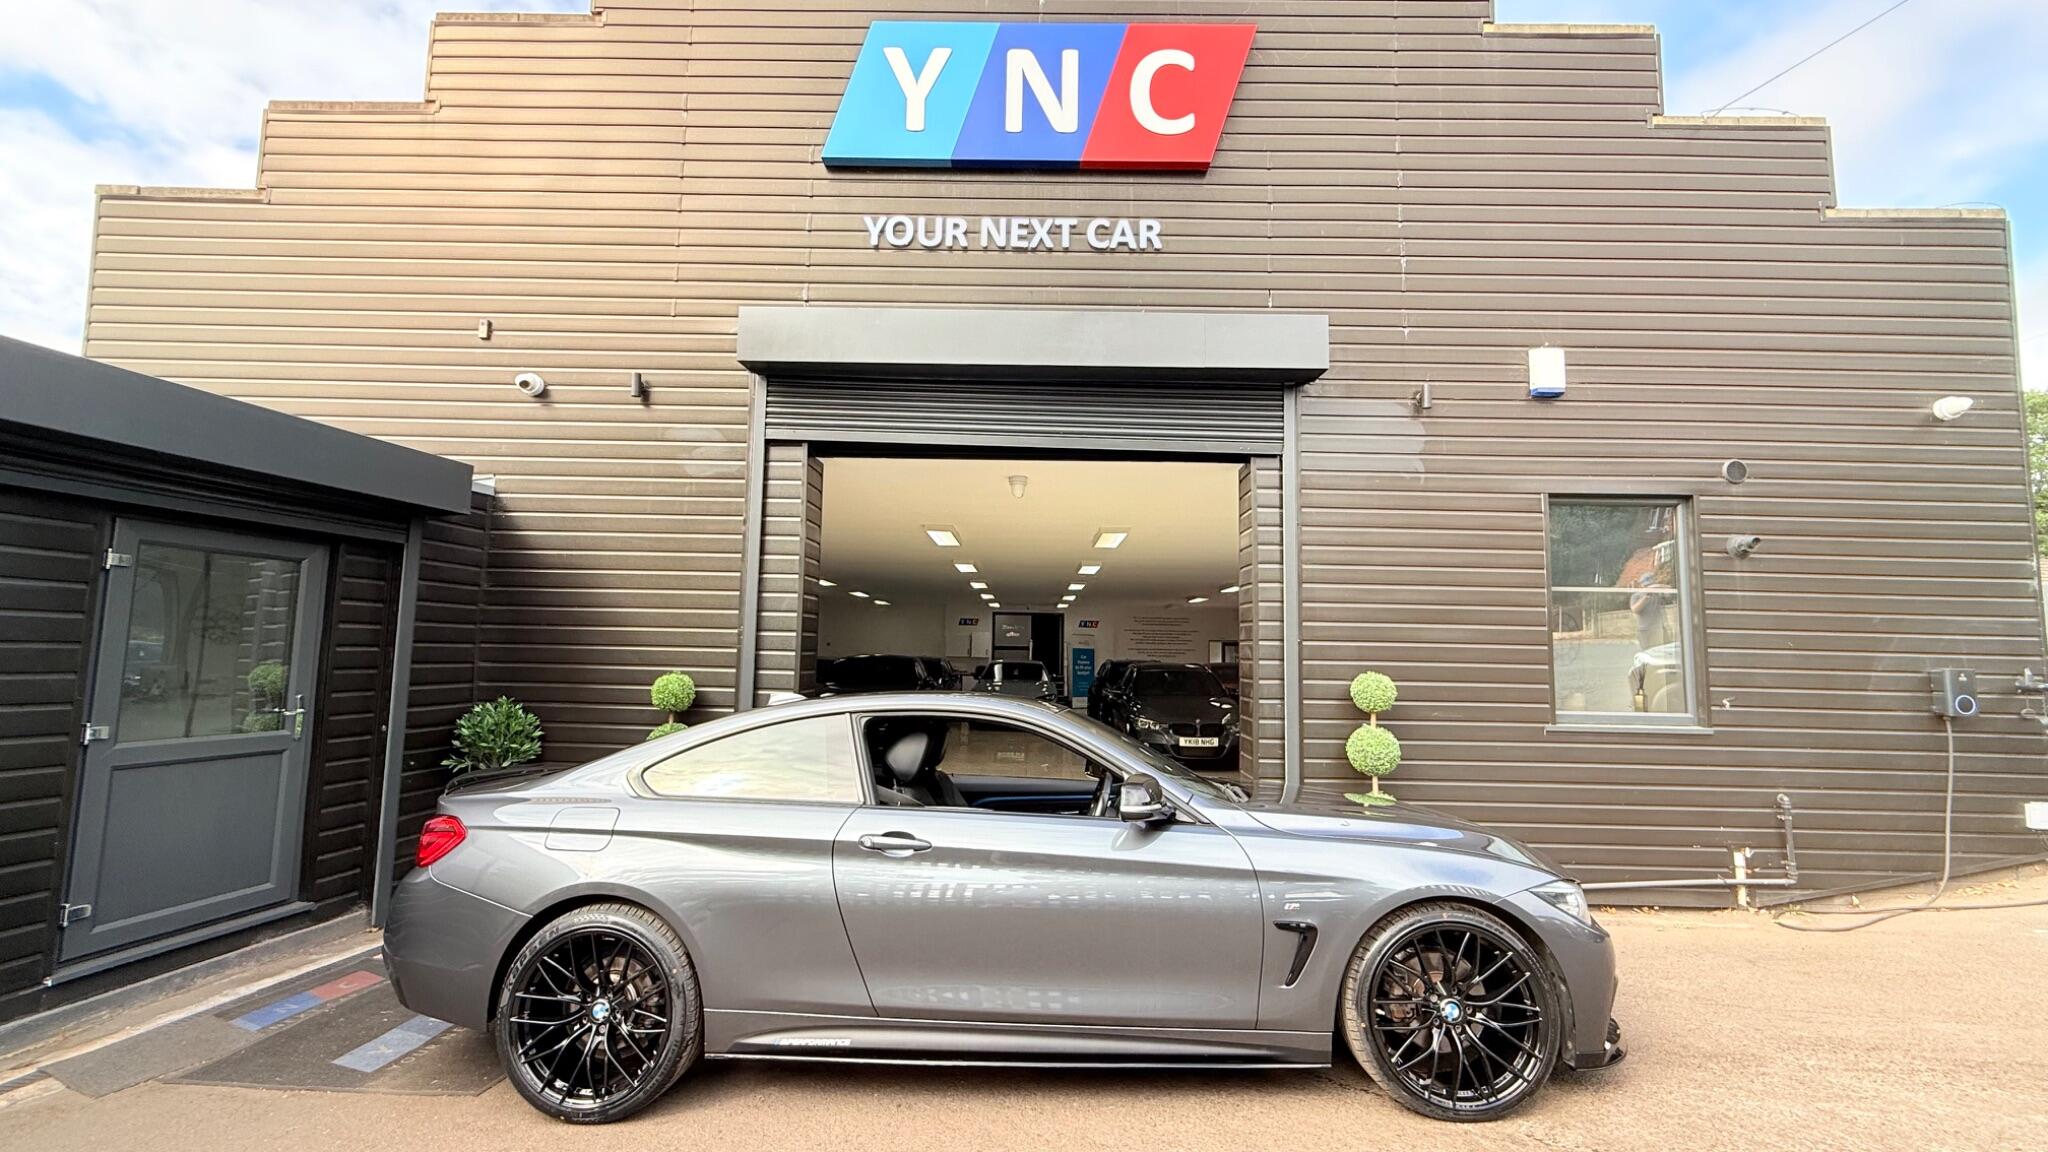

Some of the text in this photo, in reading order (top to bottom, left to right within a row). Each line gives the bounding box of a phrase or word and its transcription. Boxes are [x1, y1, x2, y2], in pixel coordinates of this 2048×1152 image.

[863, 215, 1163, 250] YOUR NEXT CAR
